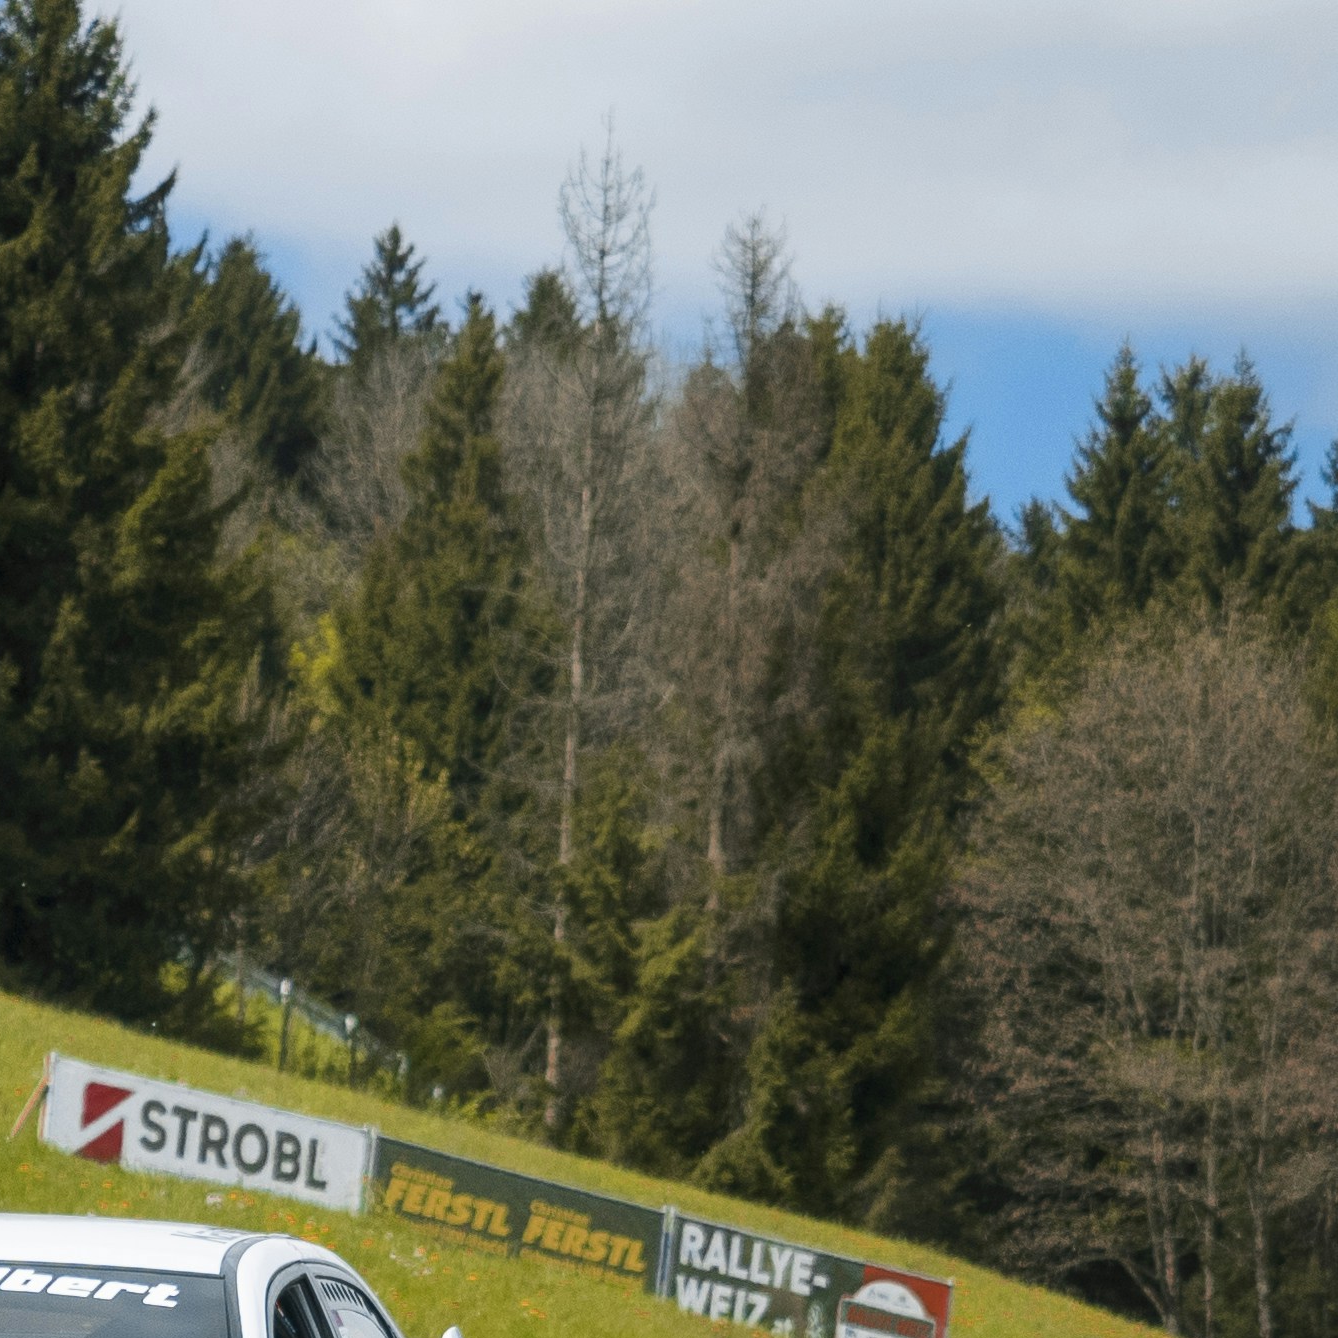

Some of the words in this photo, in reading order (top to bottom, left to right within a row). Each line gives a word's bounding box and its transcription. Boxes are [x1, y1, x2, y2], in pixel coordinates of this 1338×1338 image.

[140, 1100, 327, 1191] STROBL
[384, 1177, 511, 1236] FERSTL
[523, 1215, 646, 1272] FERSTL
[679, 1223, 830, 1296] RALLYE-
